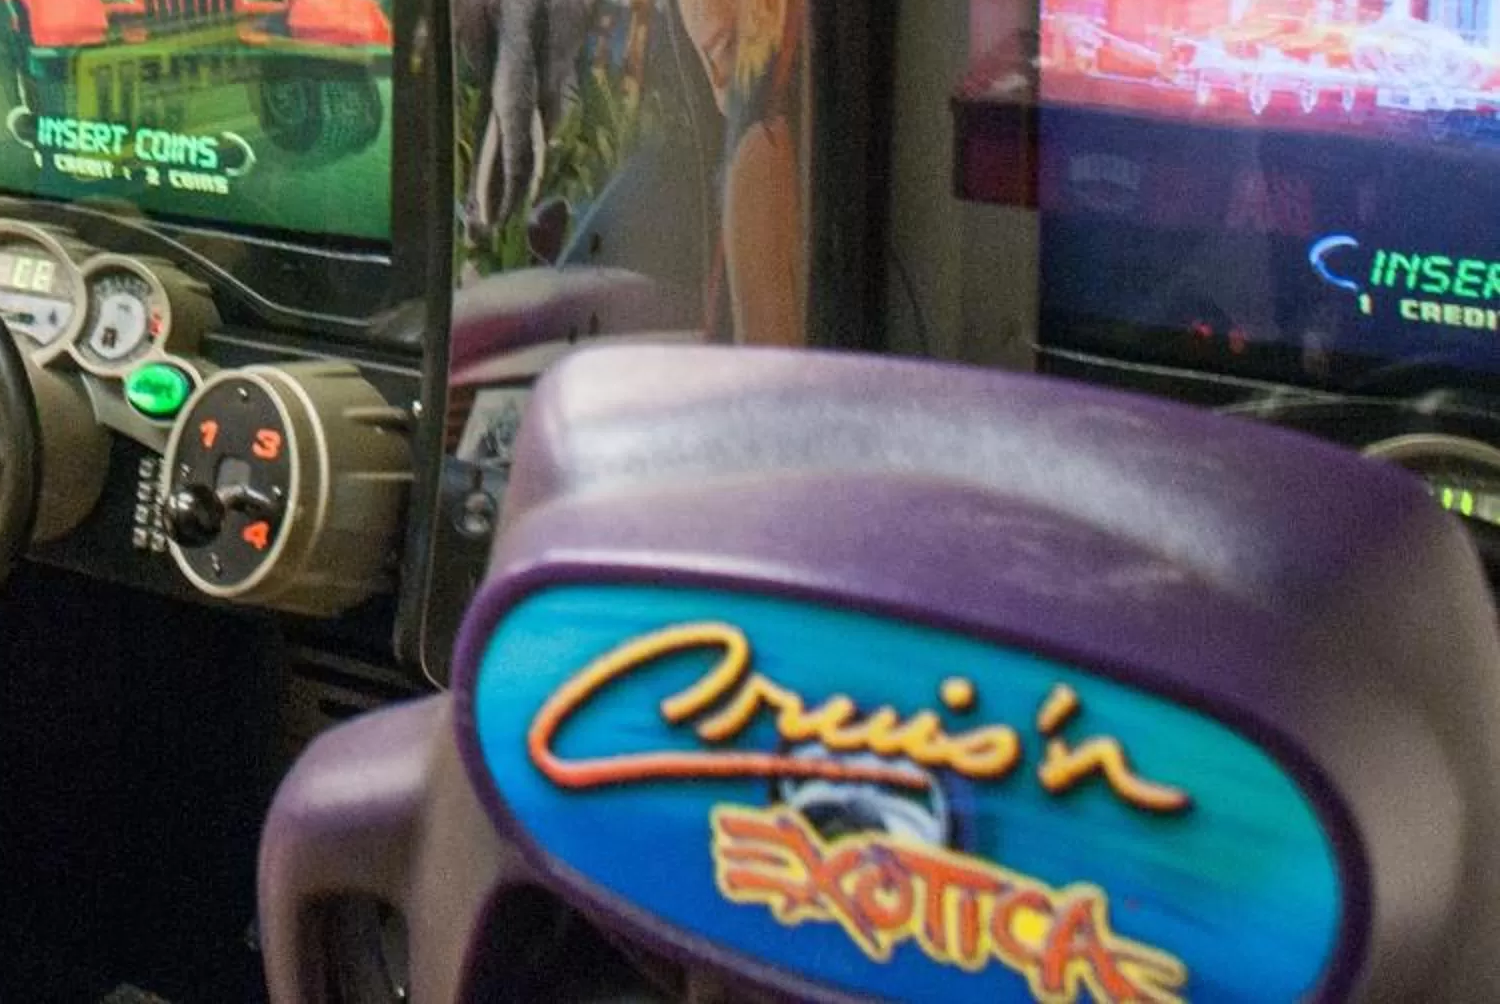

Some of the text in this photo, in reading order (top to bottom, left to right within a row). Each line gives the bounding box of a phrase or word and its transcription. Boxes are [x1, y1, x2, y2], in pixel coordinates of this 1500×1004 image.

[37, 115, 219, 169] INSERT COINS
[145, 166, 161, 186] 2
[168, 169, 230, 195] COINS
[1359, 293, 1373, 316] 1
[199, 419, 281, 459] 1 3
[241, 521, 271, 549] 4
[530, 622, 1190, 810] Cruis'n
[708, 804, 1190, 1004] EXOTICA
